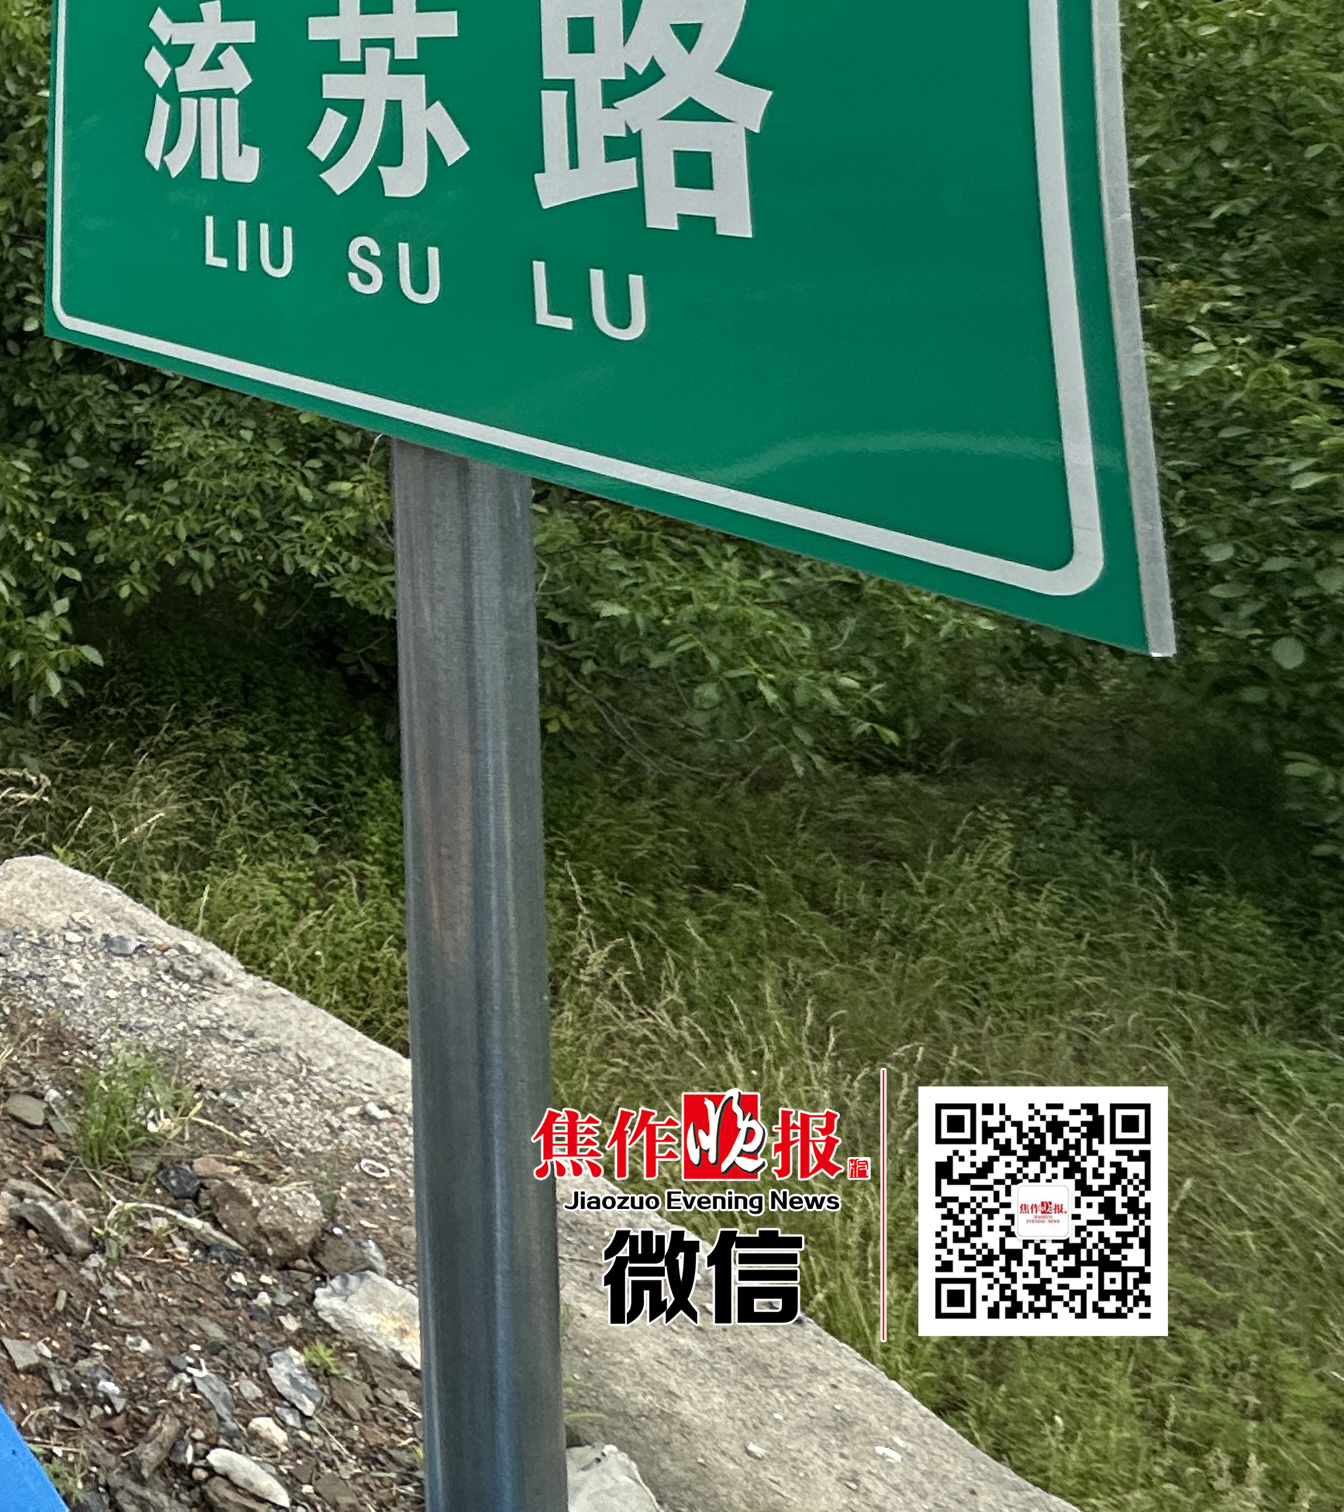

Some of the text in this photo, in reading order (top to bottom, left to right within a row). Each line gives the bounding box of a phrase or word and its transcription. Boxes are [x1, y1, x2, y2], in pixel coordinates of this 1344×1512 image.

[204, 215, 648, 342] LIU SU LU
